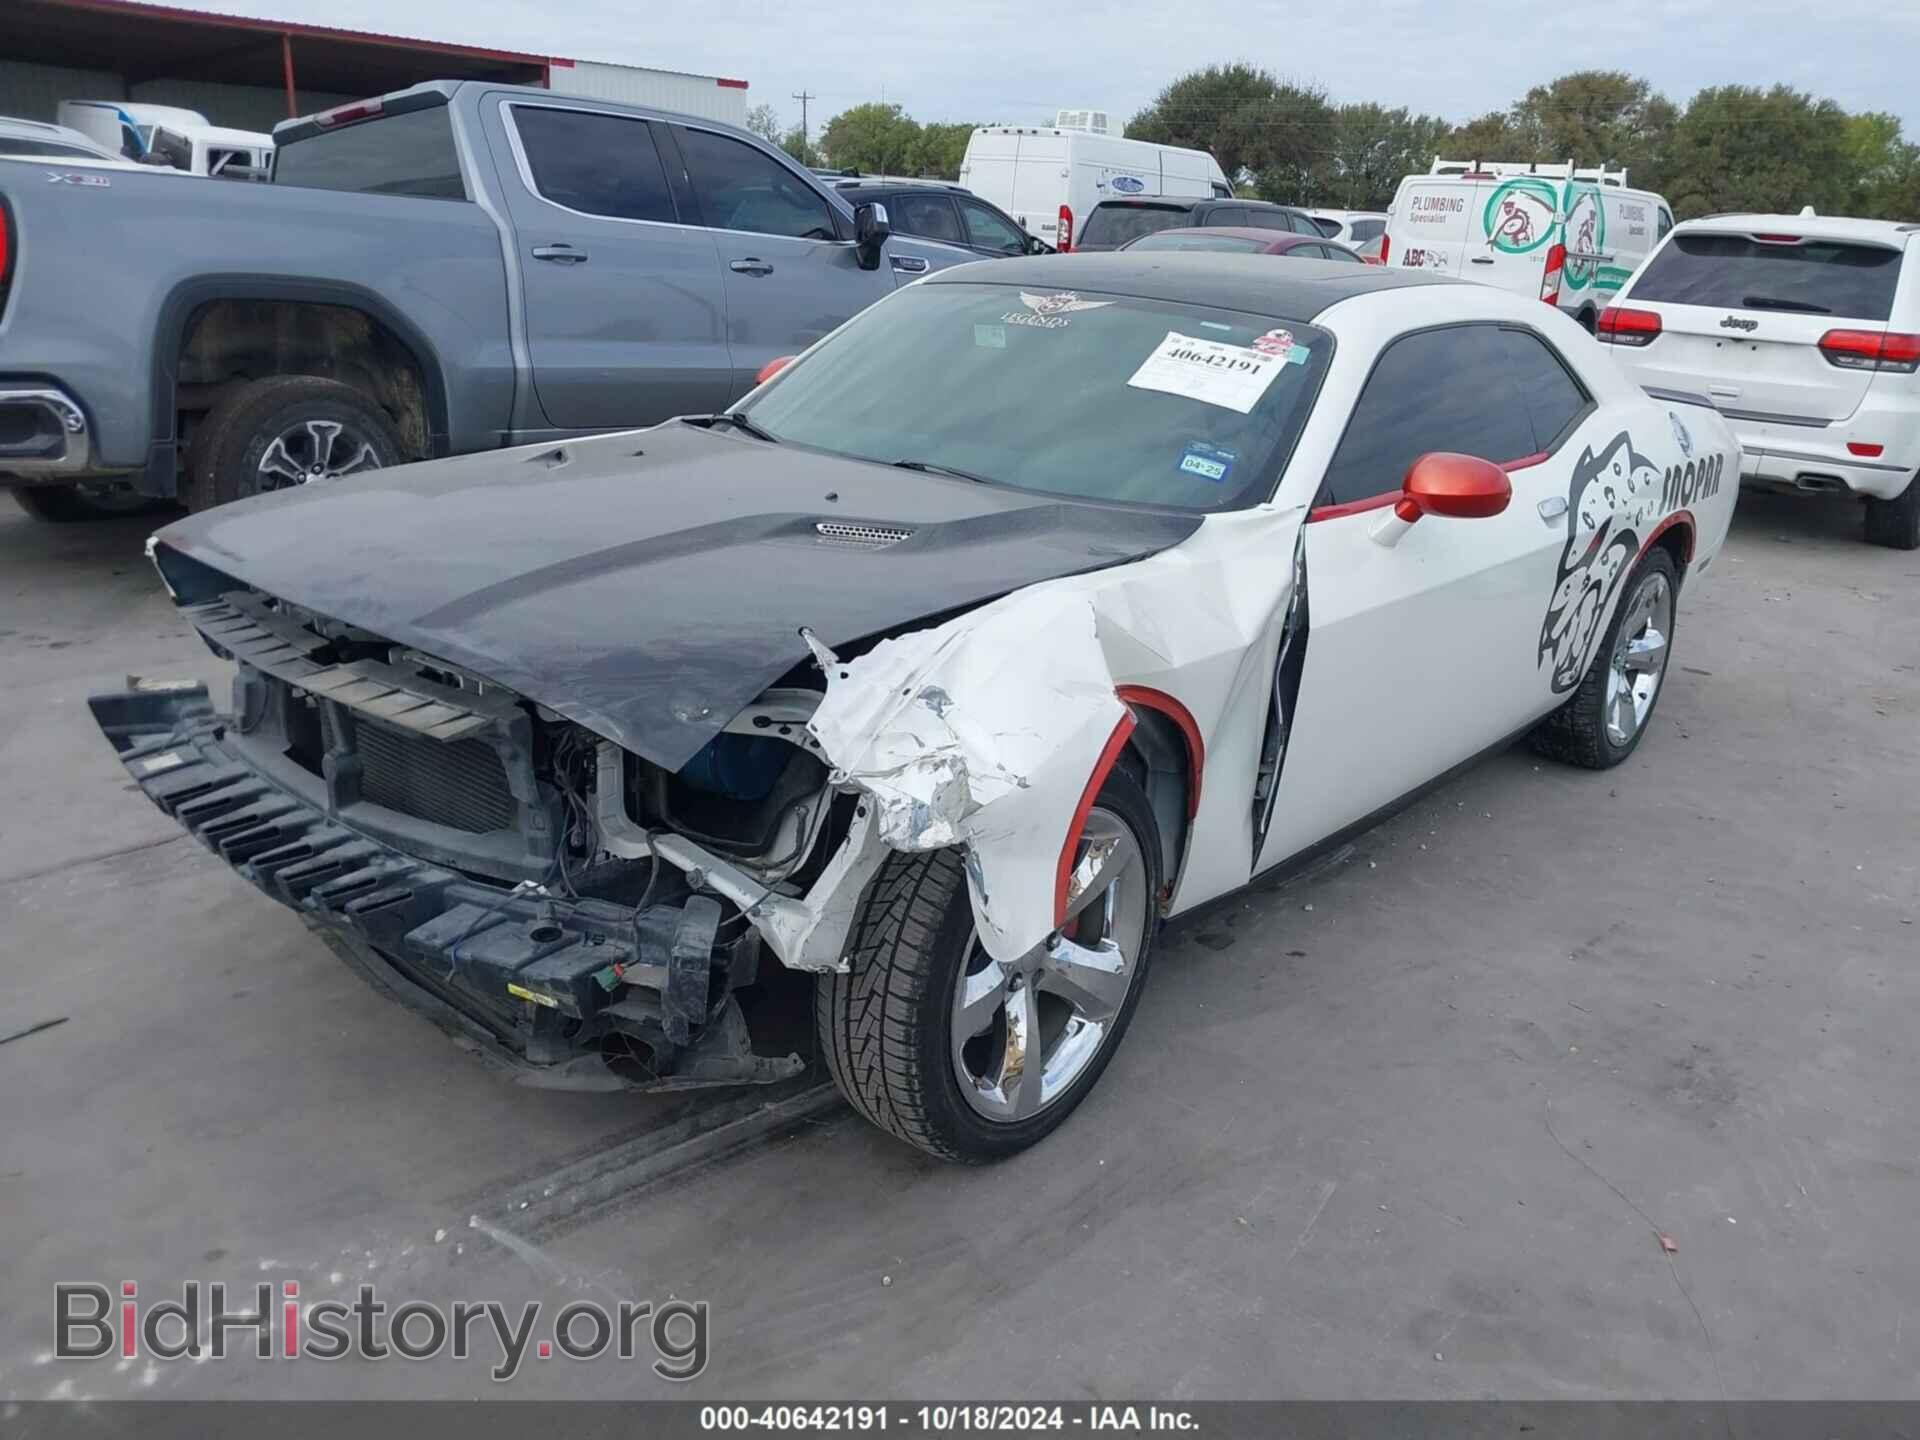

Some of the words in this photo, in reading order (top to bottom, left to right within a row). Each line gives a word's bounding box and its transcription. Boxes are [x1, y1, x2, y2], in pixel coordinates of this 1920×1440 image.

[1411, 196, 1464, 213] PLUMBING
[1408, 212, 1447, 224] Specialist
[1402, 248, 1426, 267] ABC
[1720, 315, 1758, 332] Jeep
[1167, 348, 1261, 375] 40642191
